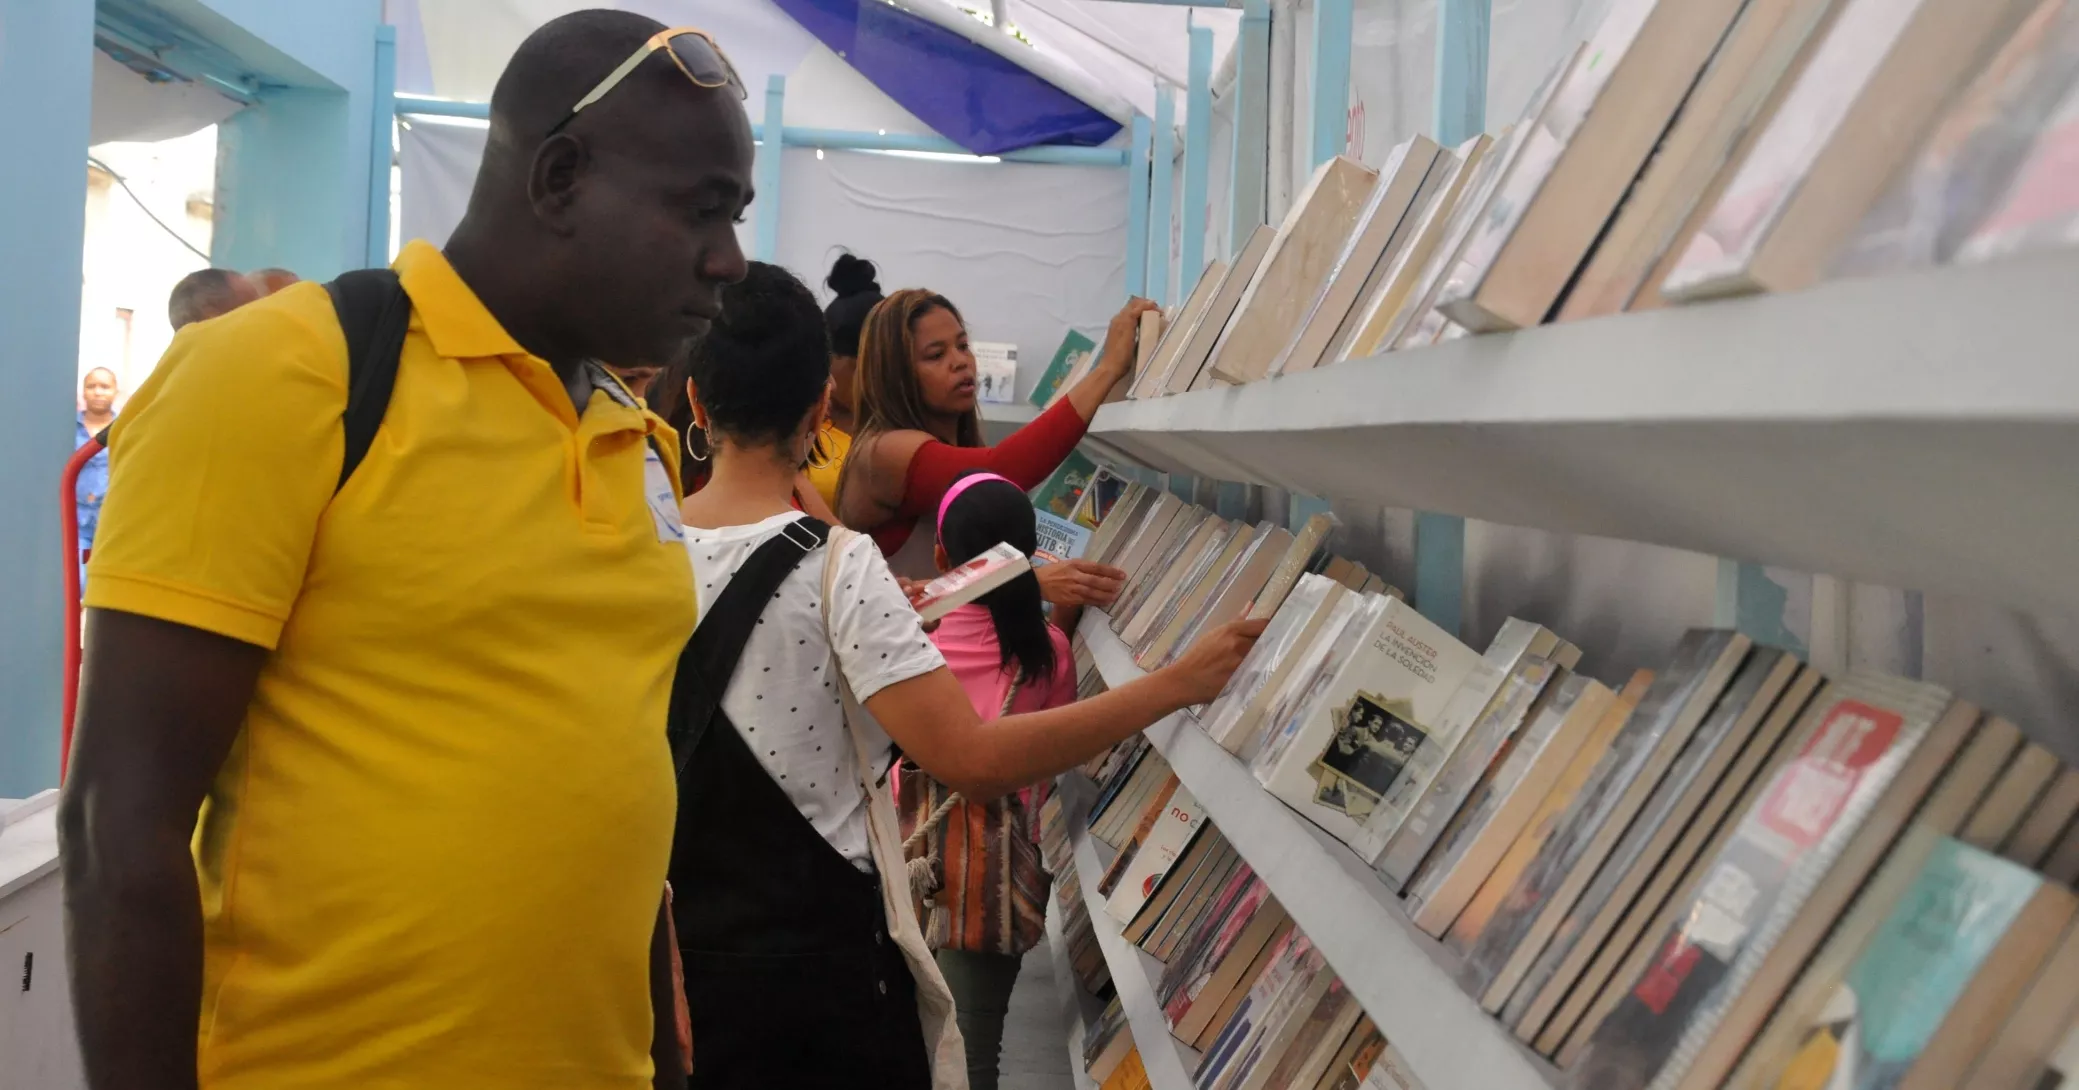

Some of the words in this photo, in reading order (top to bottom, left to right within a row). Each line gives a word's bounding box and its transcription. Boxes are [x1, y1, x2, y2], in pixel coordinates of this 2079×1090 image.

[1036, 523, 1068, 543] HISTORIA
[1380, 631, 1391, 642] LA
[1386, 621, 1405, 639] PAUL
[1407, 636, 1438, 658] AUSTER
[1373, 639, 1388, 652] DE
[1385, 649, 1397, 660] LA
[1397, 656, 1436, 684] SOLEDAD
[1171, 807, 1189, 823] no
